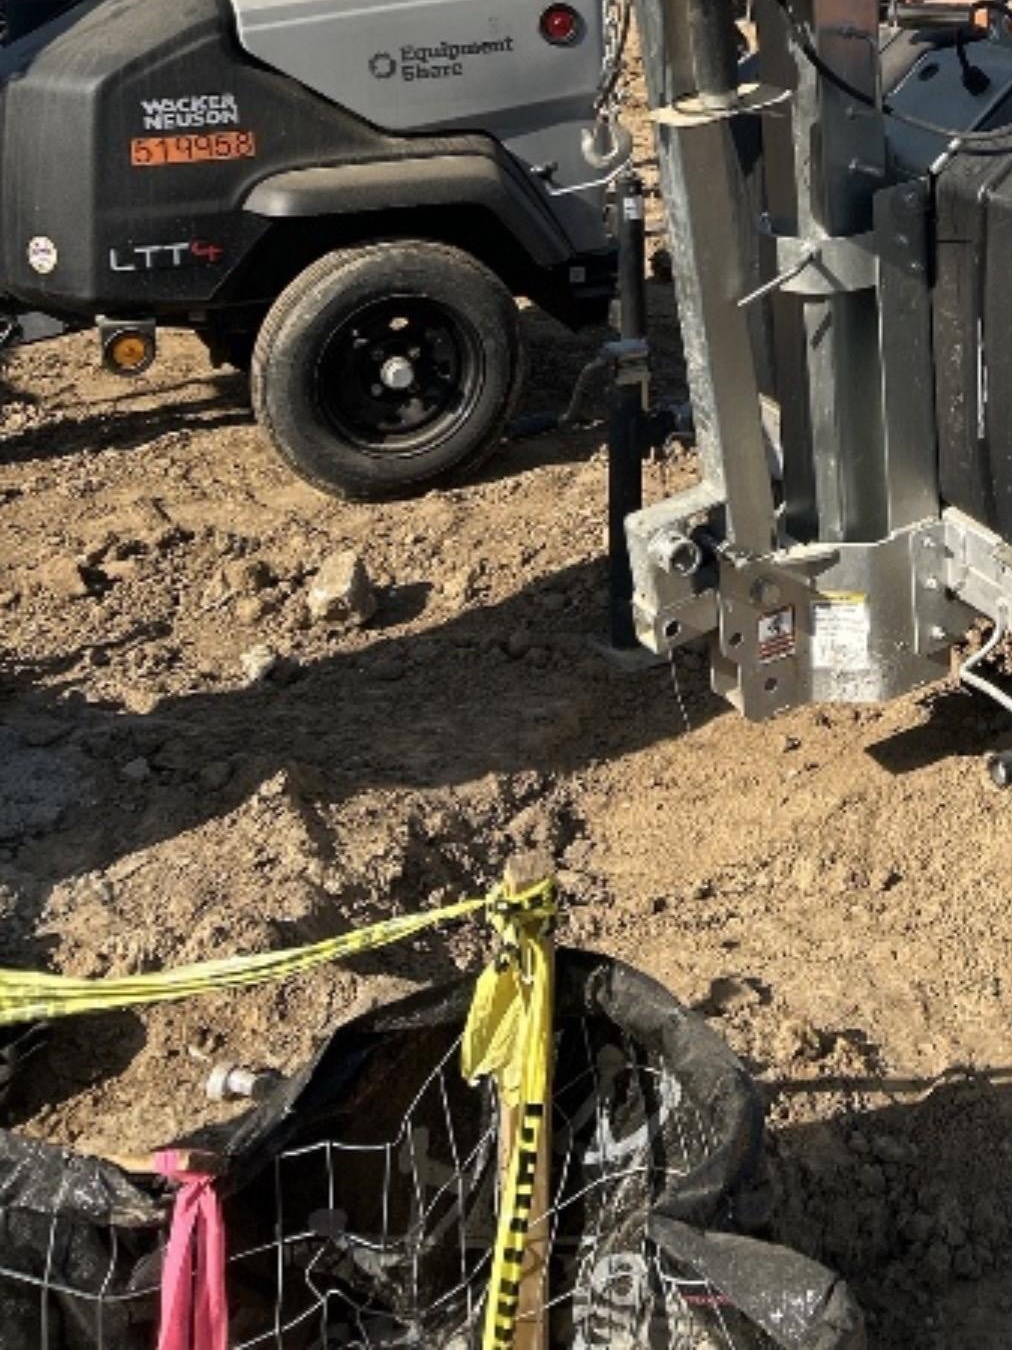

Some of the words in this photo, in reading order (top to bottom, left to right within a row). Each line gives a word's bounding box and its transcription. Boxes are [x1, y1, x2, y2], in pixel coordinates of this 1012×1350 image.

[400, 37, 514, 63] Equipment
[401, 62, 463, 82] Share
[140, 93, 236, 115] WACKER
[143, 110, 240, 130] NEUSON
[134, 132, 254, 163] 519958
